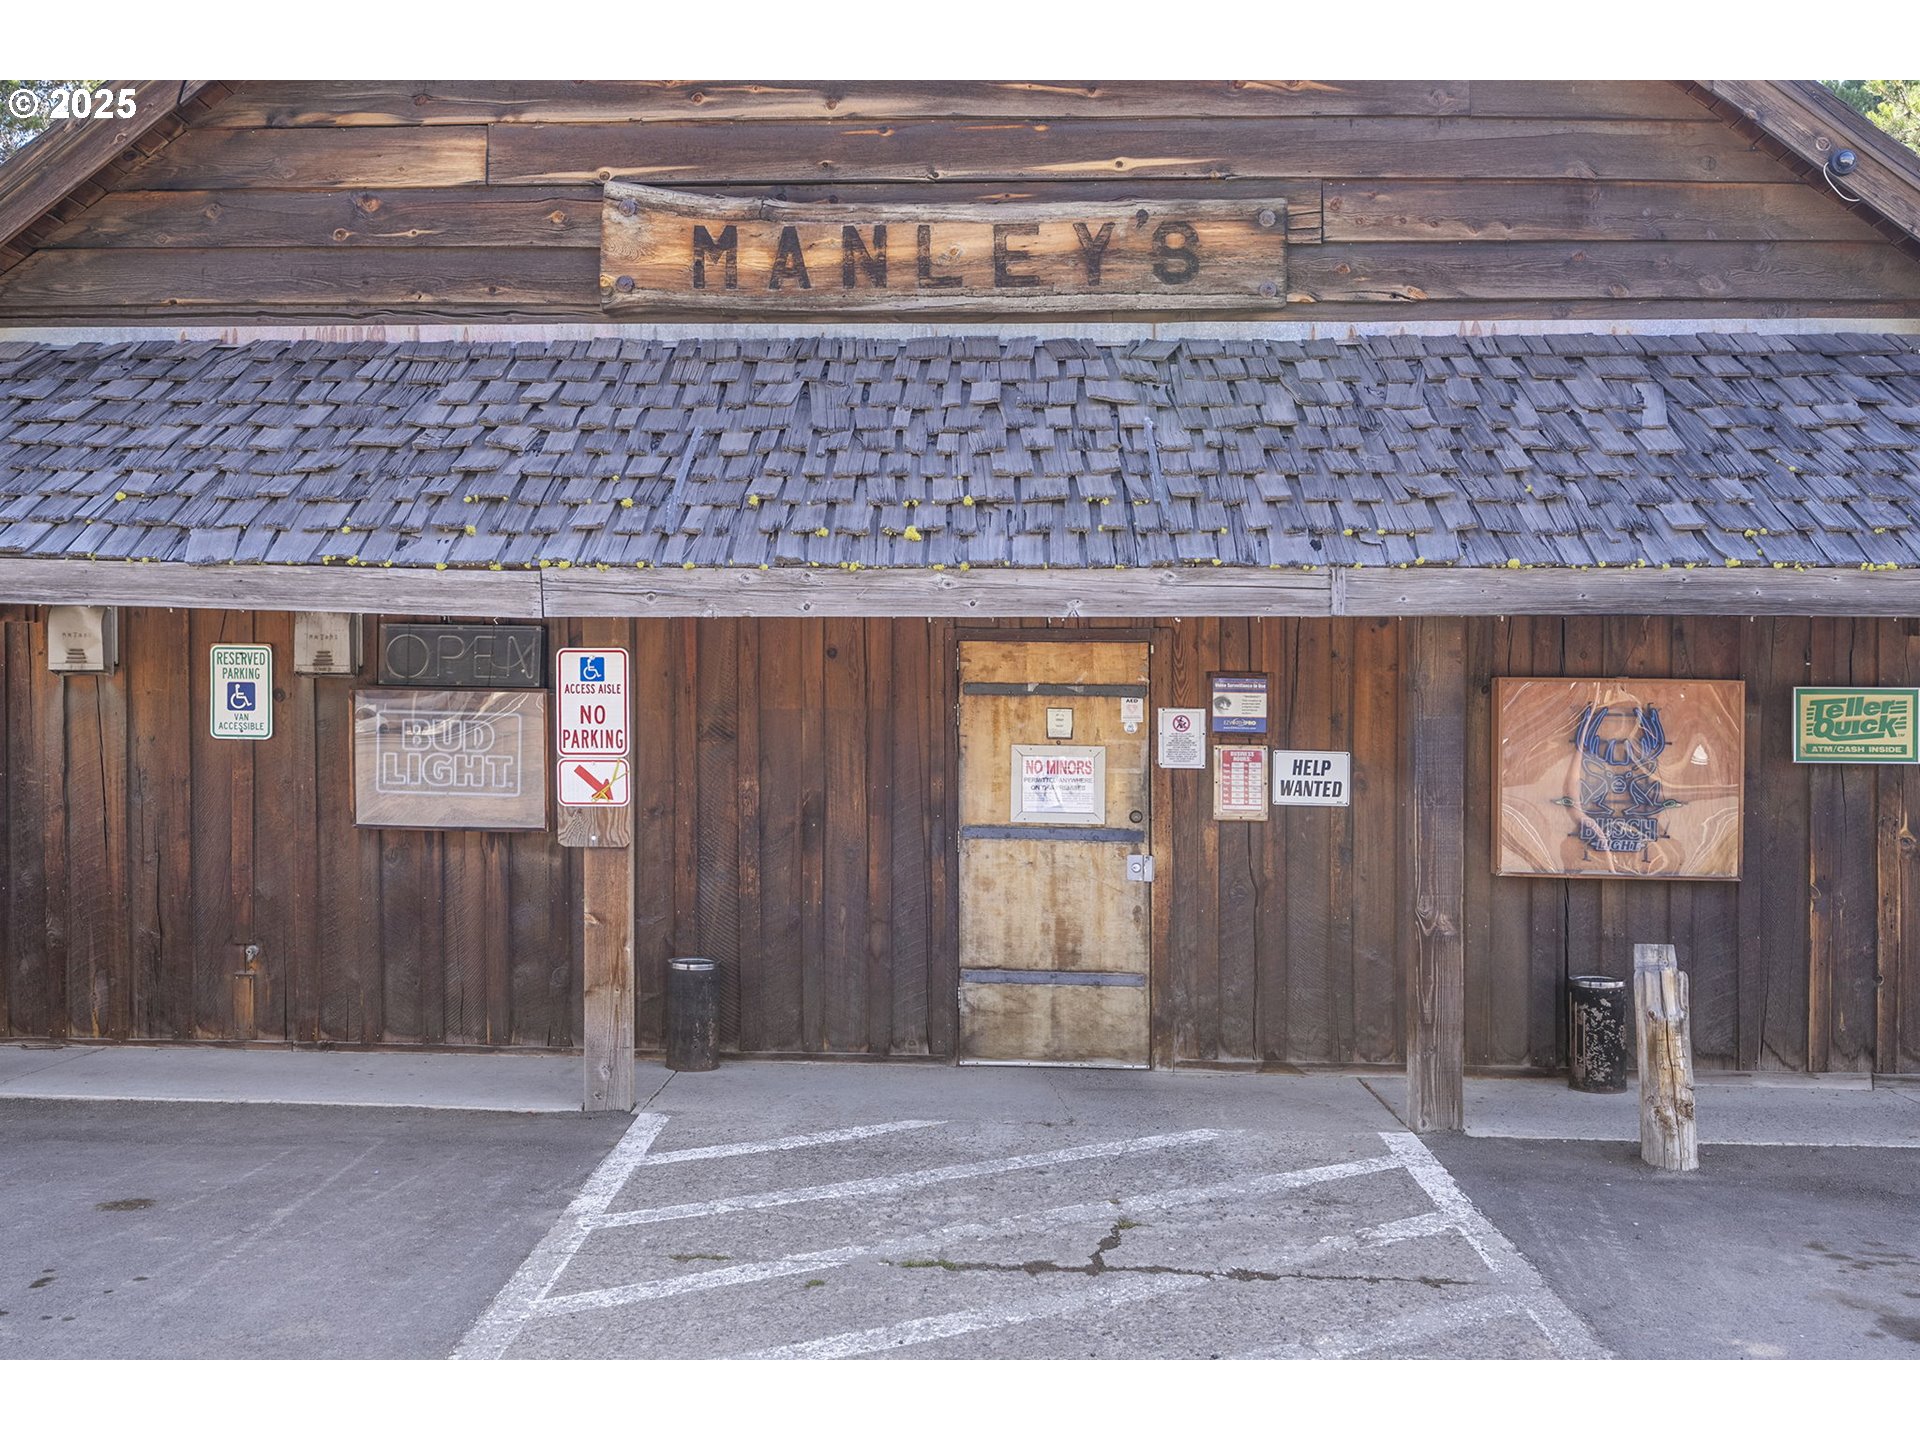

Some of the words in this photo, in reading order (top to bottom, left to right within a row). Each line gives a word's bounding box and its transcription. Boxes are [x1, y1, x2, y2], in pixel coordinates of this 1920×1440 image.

[692, 208, 1201, 291] MANLEY'S
[216, 651, 266, 666] RESERVED
[386, 634, 536, 679] OPEN
[222, 667, 261, 680] PARKING
[564, 683, 596, 694] ACCESS
[598, 683, 621, 694] AISLE
[233, 713, 250, 721] VAN
[580, 705, 606, 724] NO
[1809, 696, 1896, 722] Teller
[218, 721, 265, 732] ACCESSIBLE
[401, 718, 496, 753] BUD
[562, 729, 624, 749] PARKING
[1811, 745, 1865, 753] ATM/CASH
[1868, 745, 1903, 753] INSIDE
[382, 752, 514, 788] LIGHT
[1025, 760, 1043, 775] NO
[1046, 760, 1093, 775] MINORS
[1292, 759, 1332, 776] HELP
[1280, 780, 1343, 798] WANTED
[1580, 817, 1658, 842] BUSCH
